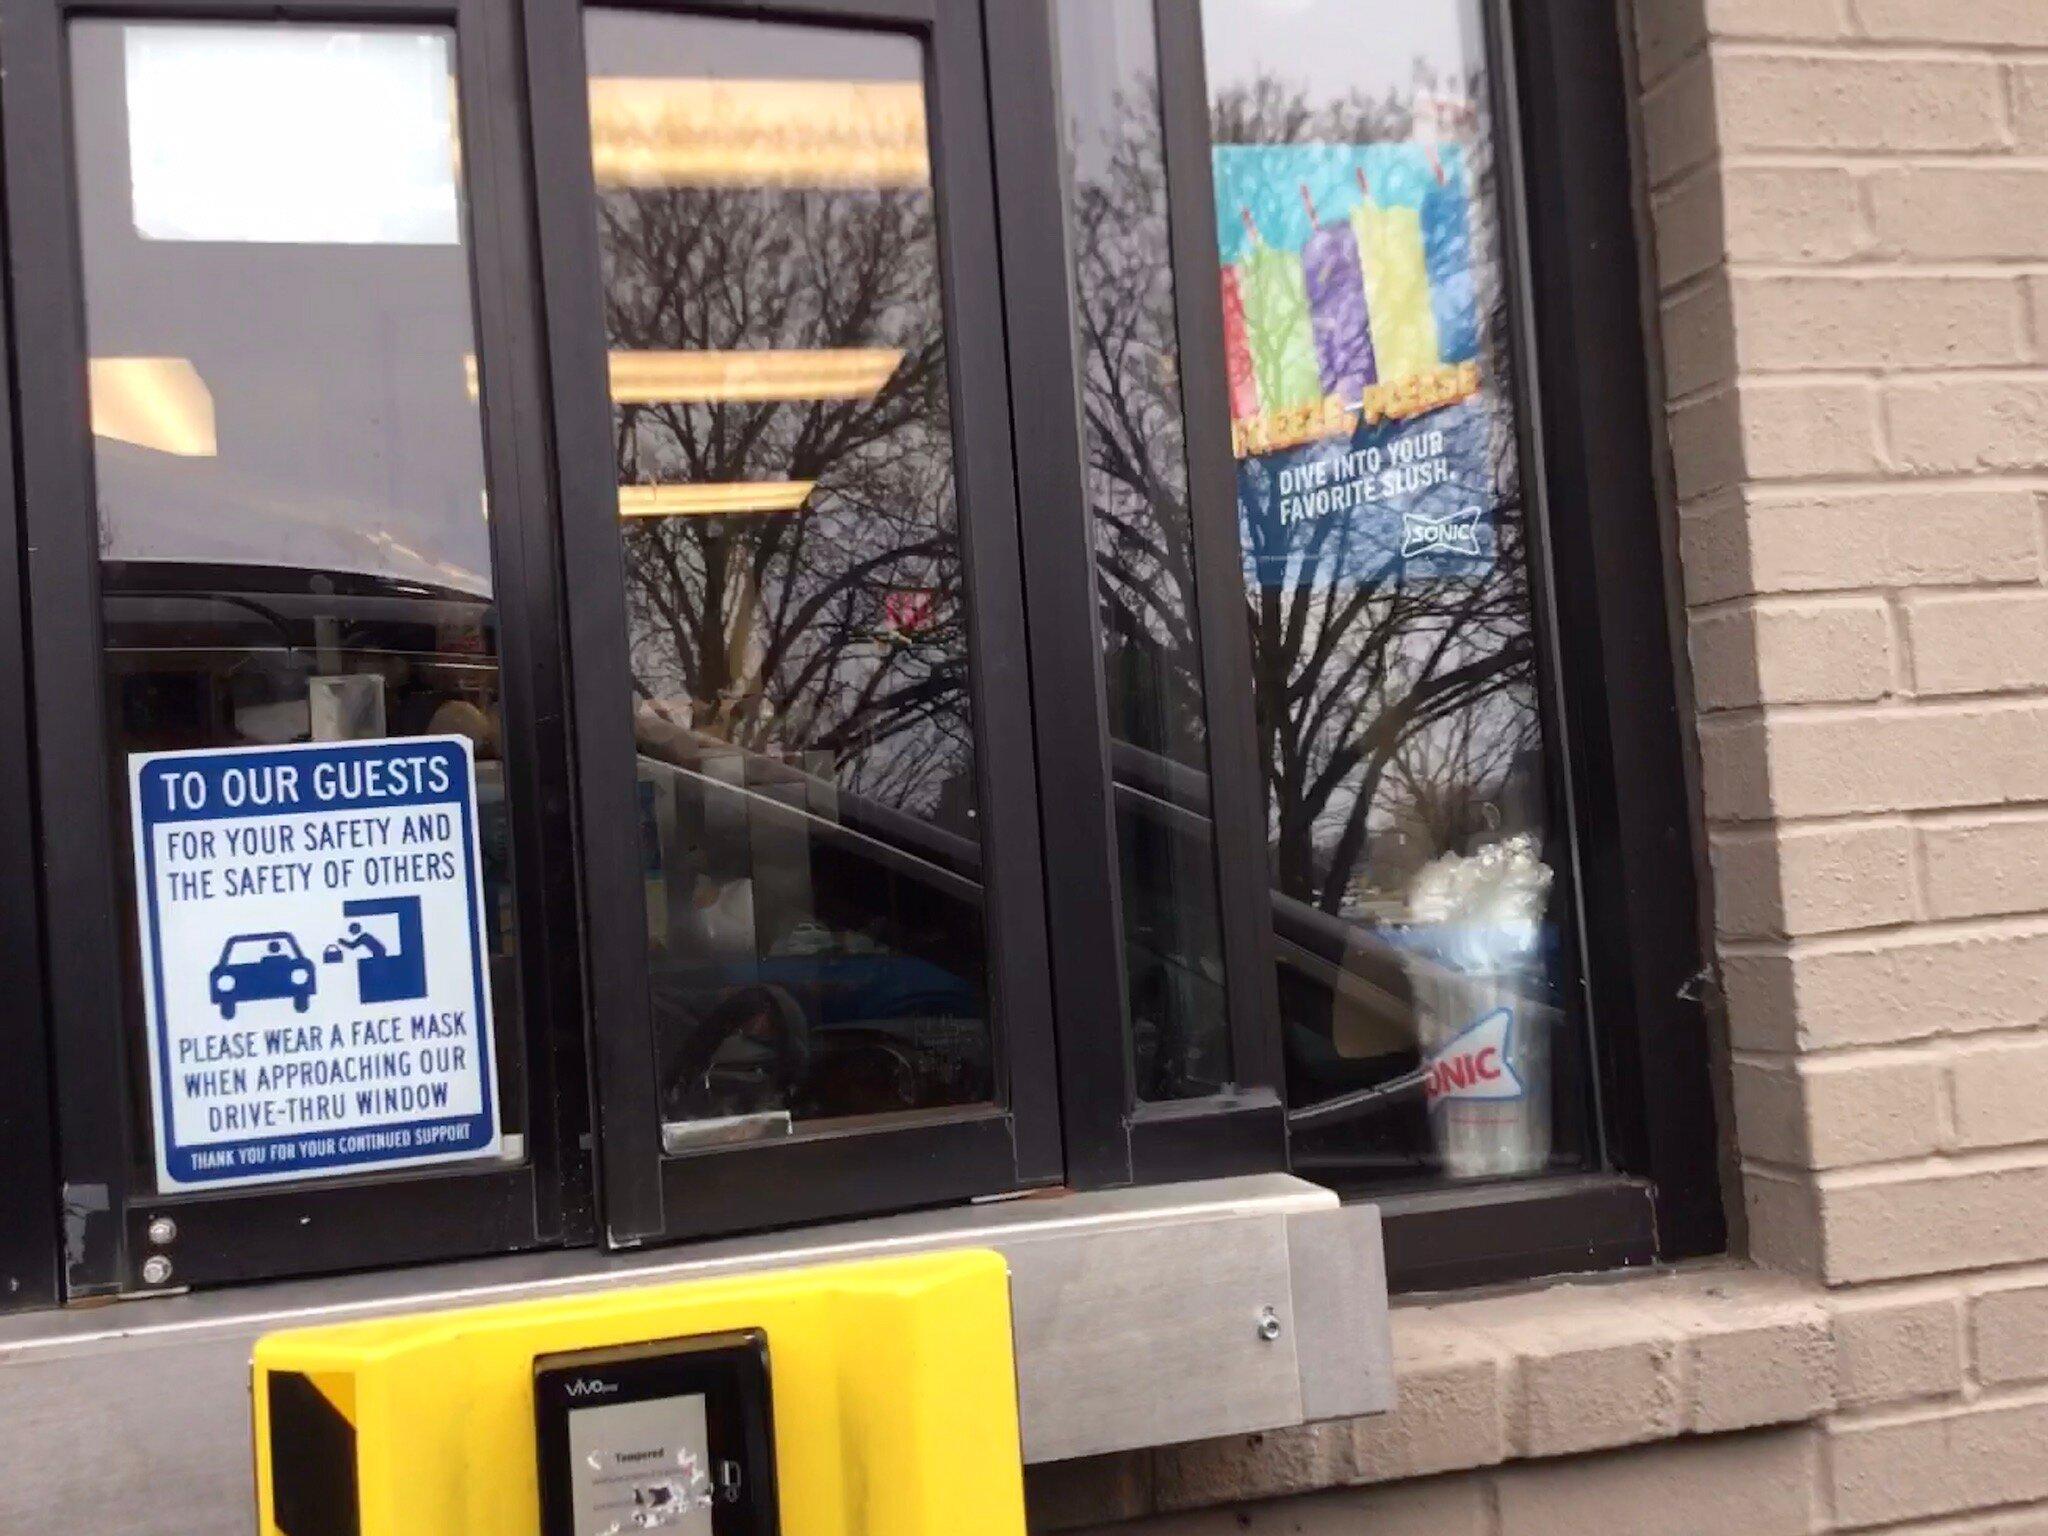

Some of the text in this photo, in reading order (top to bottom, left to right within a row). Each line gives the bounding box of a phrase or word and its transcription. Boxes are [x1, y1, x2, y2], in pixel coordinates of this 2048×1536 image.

[1279, 431, 1443, 495] DIVE INTO YOUR
[1280, 458, 1457, 525] FAVORITE SLUSH.
[1412, 524, 1471, 543] SONIC
[160, 755, 450, 811] TO OUR GUESTS
[168, 814, 451, 862] FOR YOUR SAFETY AND
[167, 852, 455, 901] THE SAFETY OF OTHERS
[179, 1011, 467, 1064] PLEASE WEAR A FACE MASK
[184, 1046, 467, 1099] WHEN APPROACHING OUR
[1424, 1047, 1500, 1097] ONIC
[209, 1082, 449, 1133] DRIVE-THRU WINDOW
[190, 1124, 470, 1171] THANK YOU FOR YOUR CONTINUED SUPPORT
